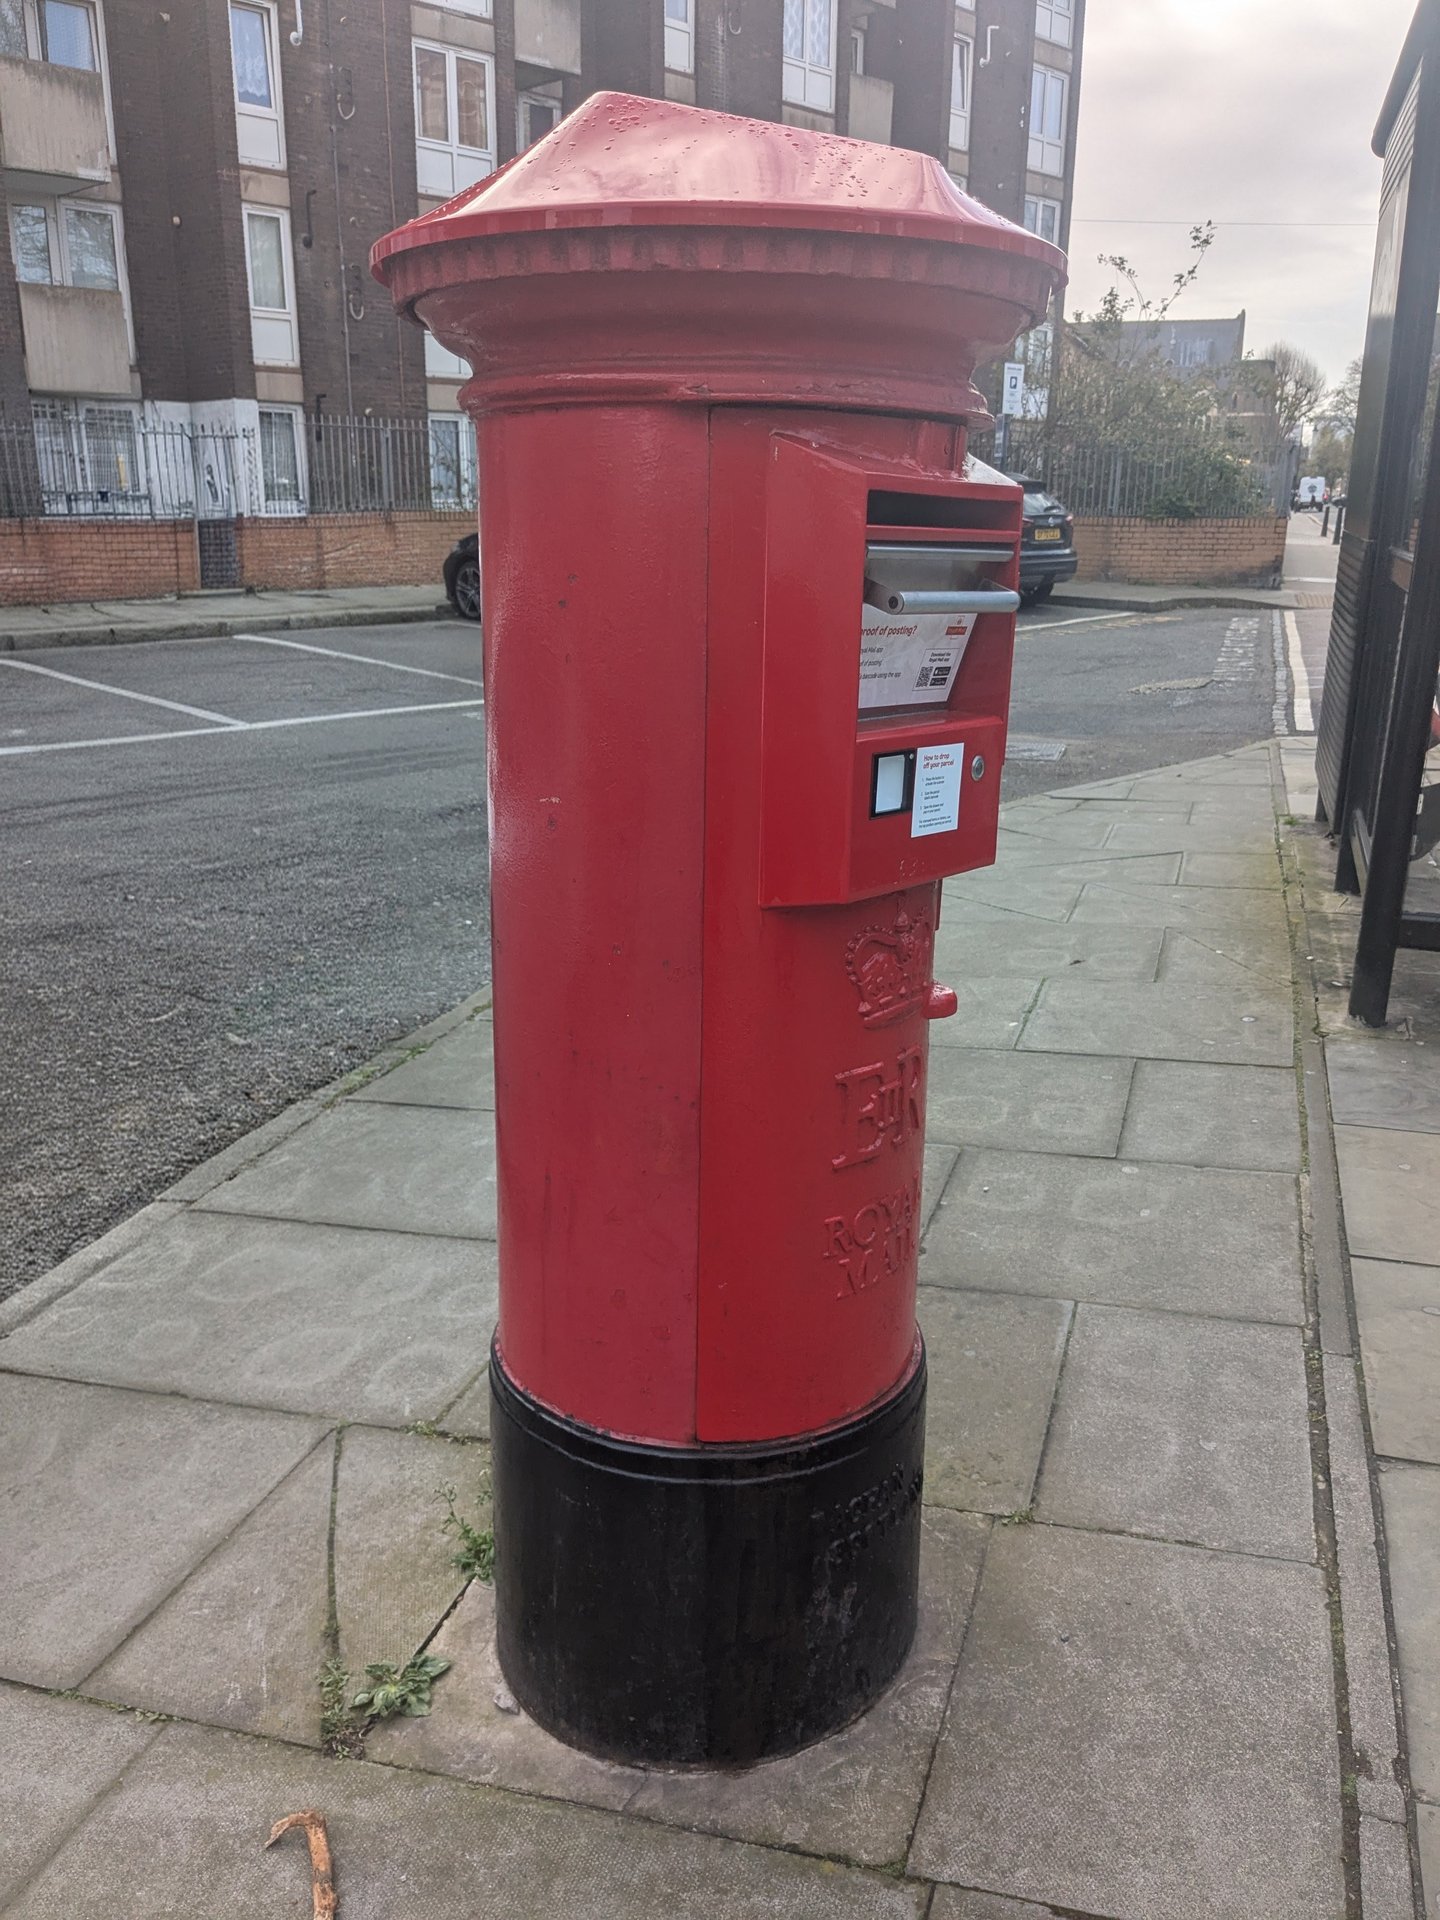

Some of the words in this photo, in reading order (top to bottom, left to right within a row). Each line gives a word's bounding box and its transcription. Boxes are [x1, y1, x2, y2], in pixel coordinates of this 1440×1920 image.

[879, 625, 889, 636] of
[886, 625, 918, 637] posting?
[923, 754, 933, 762] How
[930, 762, 940, 770] your
[940, 759, 954, 768] parcel
